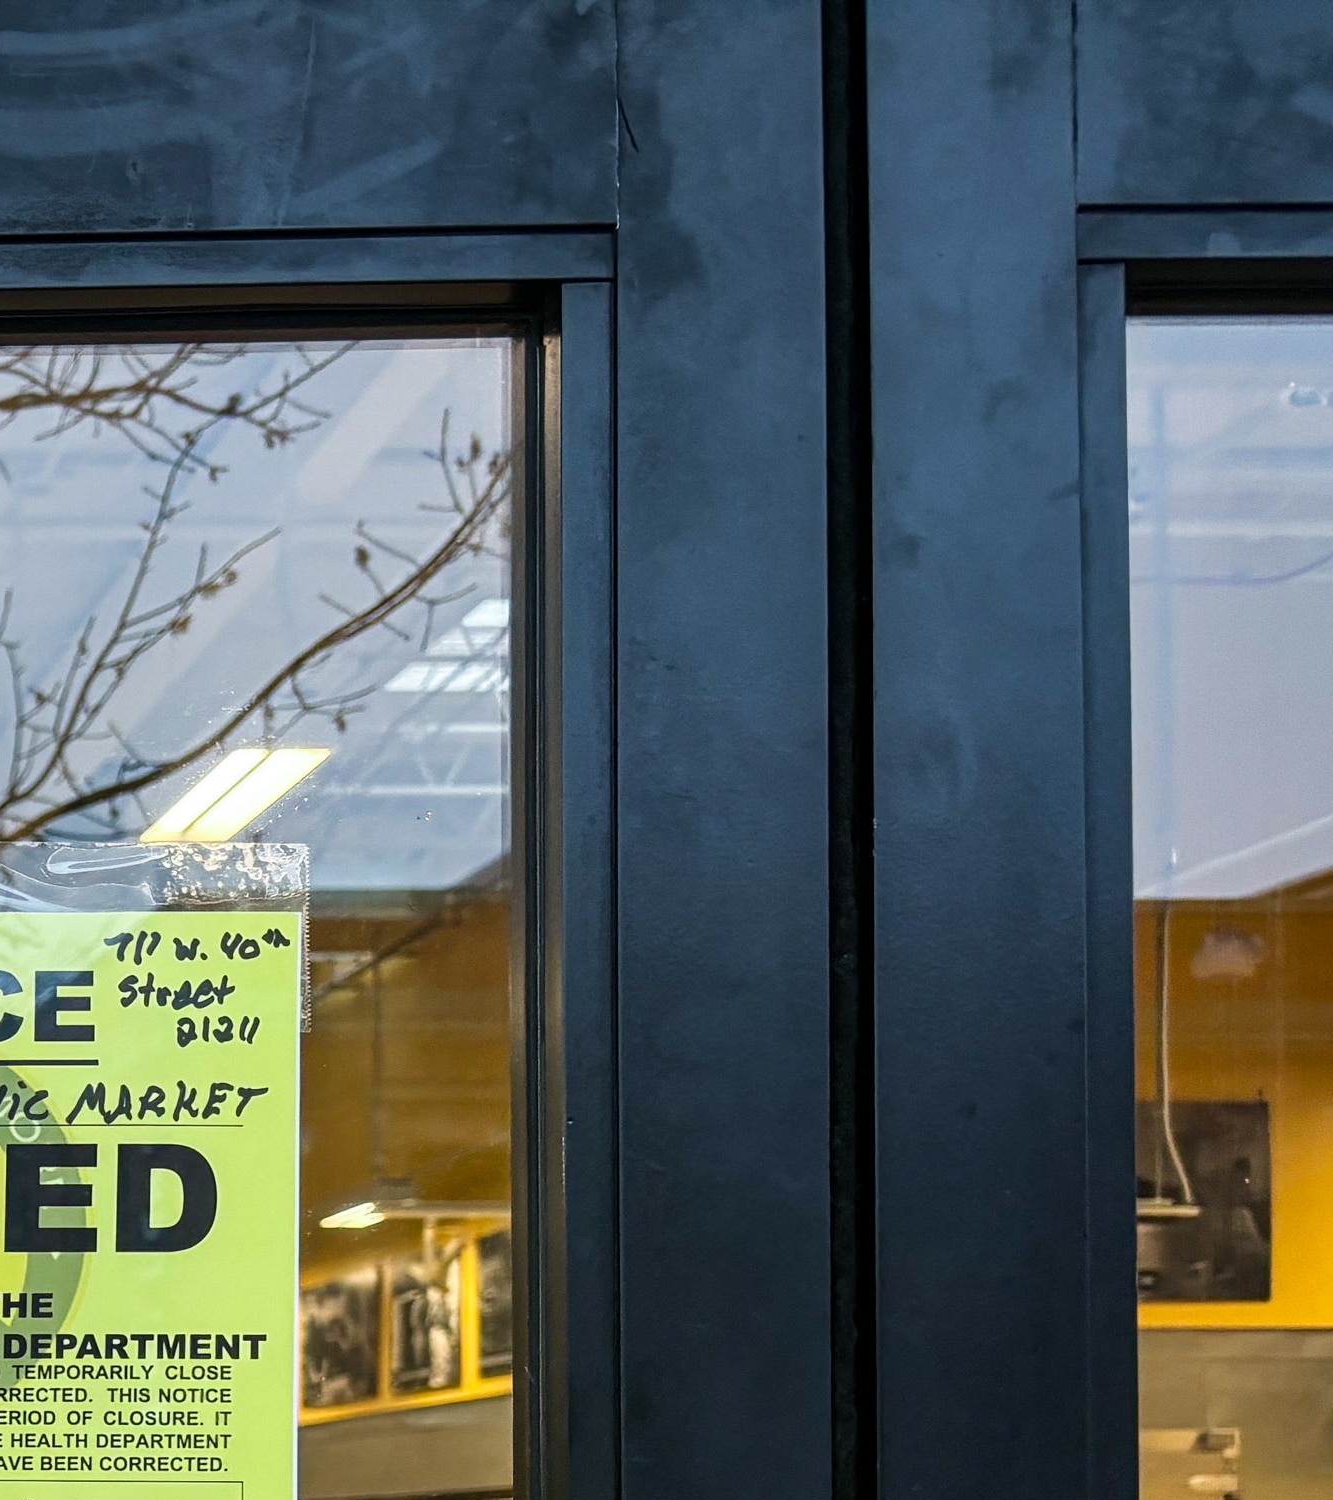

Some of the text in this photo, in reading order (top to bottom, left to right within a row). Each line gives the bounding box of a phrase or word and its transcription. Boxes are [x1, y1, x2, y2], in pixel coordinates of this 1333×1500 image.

[65, 1080, 269, 1127] MARKET
[3, 1333, 267, 1360] DEPARTMENT
[11, 1364, 154, 1380] TEMPORARILY
[165, 1365, 232, 1380] CLOSE
[106, 1387, 151, 1403] THIS
[159, 1388, 232, 1403] NOTICE
[66, 1410, 93, 1426] OF
[103, 1410, 204, 1426] CLOSURE.
[215, 1411, 232, 1426] IT
[11, 1433, 88, 1448] HEALTH
[96, 1433, 232, 1449] DEPARTMENT
[40, 1456, 93, 1471] BEEN
[99, 1456, 228, 1472] CORRECTED.
